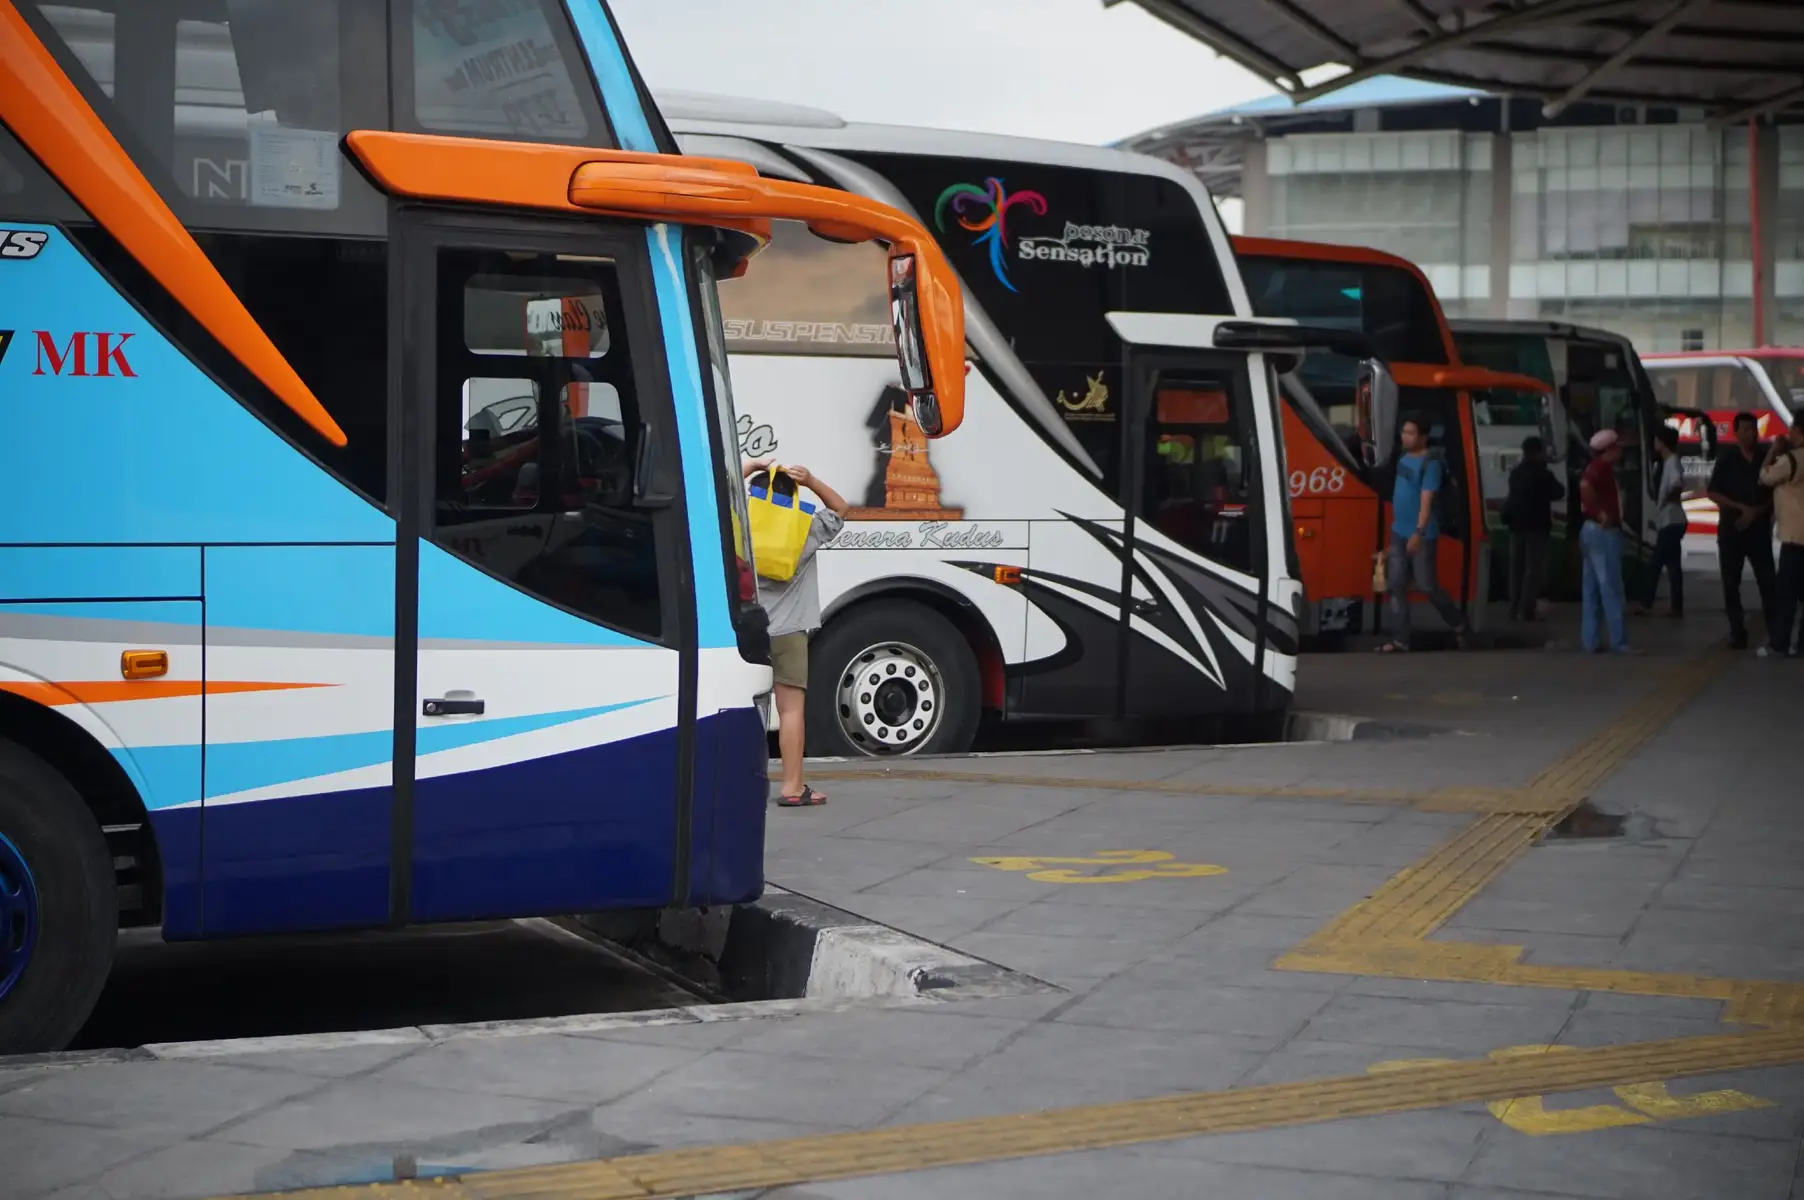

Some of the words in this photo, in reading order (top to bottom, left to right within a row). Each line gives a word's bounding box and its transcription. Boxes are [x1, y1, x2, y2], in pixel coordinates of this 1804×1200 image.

[1017, 237, 1150, 269] Sensation
[31, 330, 139, 378] MK
[1288, 466, 1347, 498] 968
[825, 529, 913, 548] enara
[918, 520, 1004, 549] Kudus
